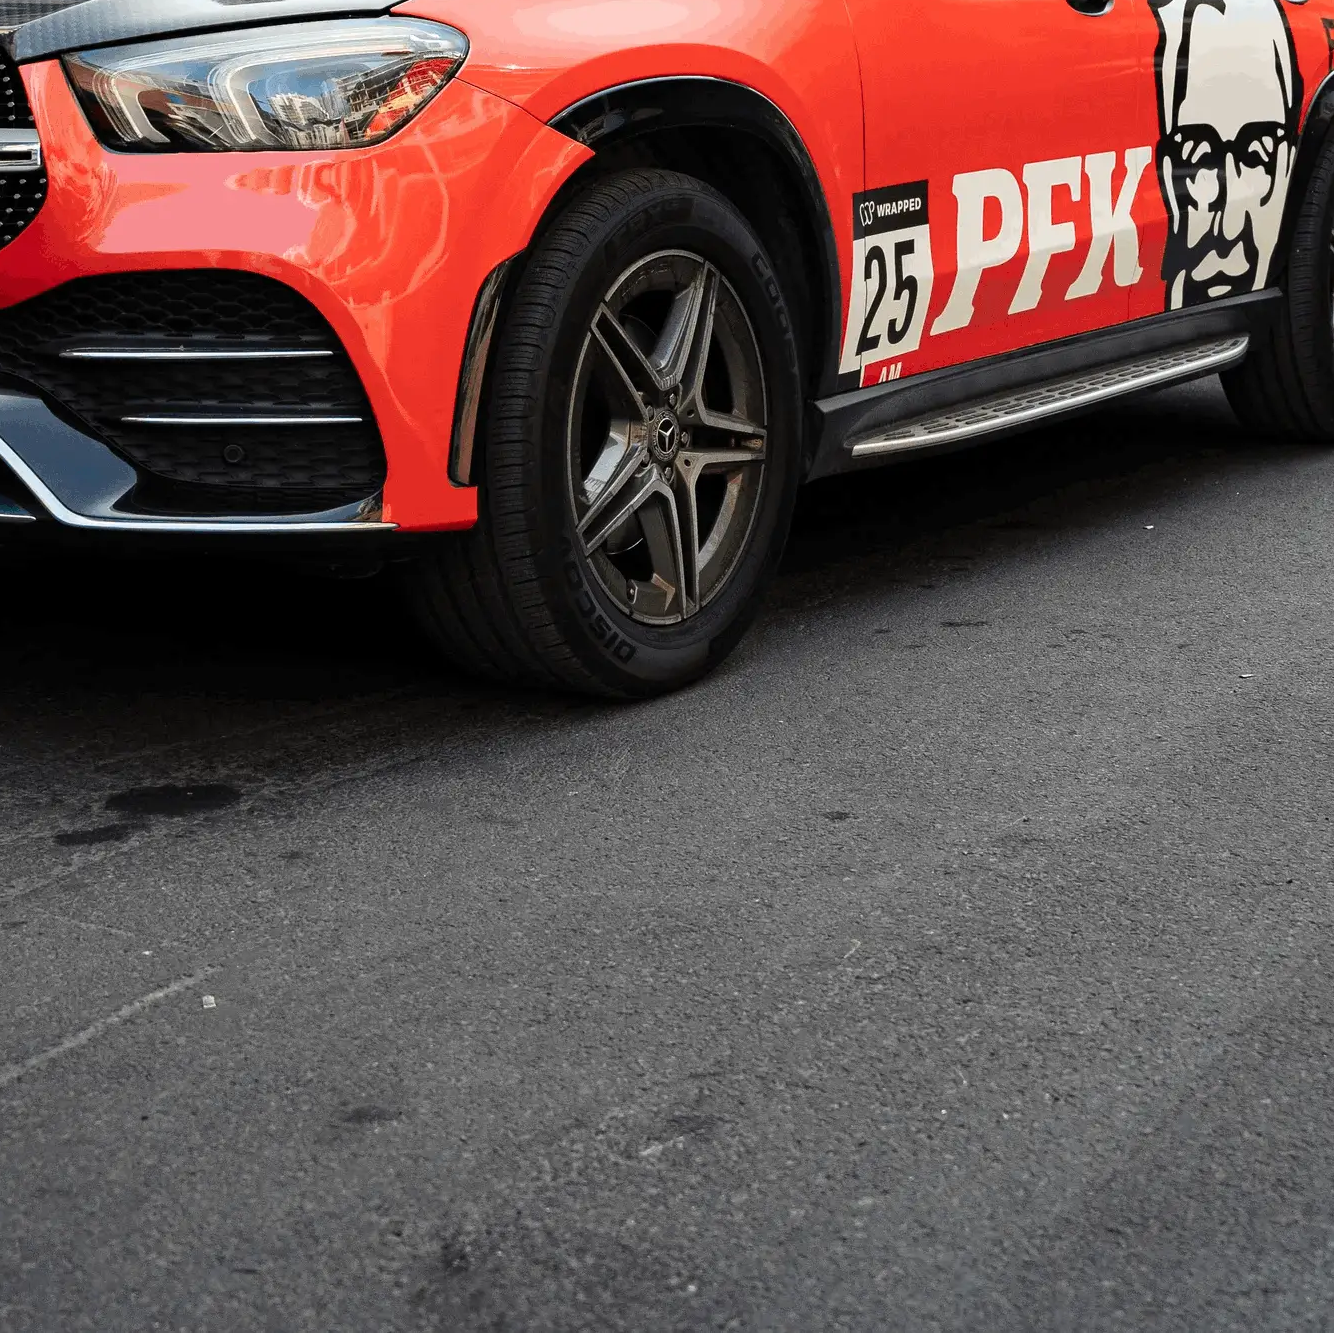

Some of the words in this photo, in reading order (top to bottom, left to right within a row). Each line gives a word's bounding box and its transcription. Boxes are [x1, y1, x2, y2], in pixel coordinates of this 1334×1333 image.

[876, 197, 922, 218] WRAPPED
[930, 146, 1152, 337] PFK
[855, 238, 919, 357] 25
